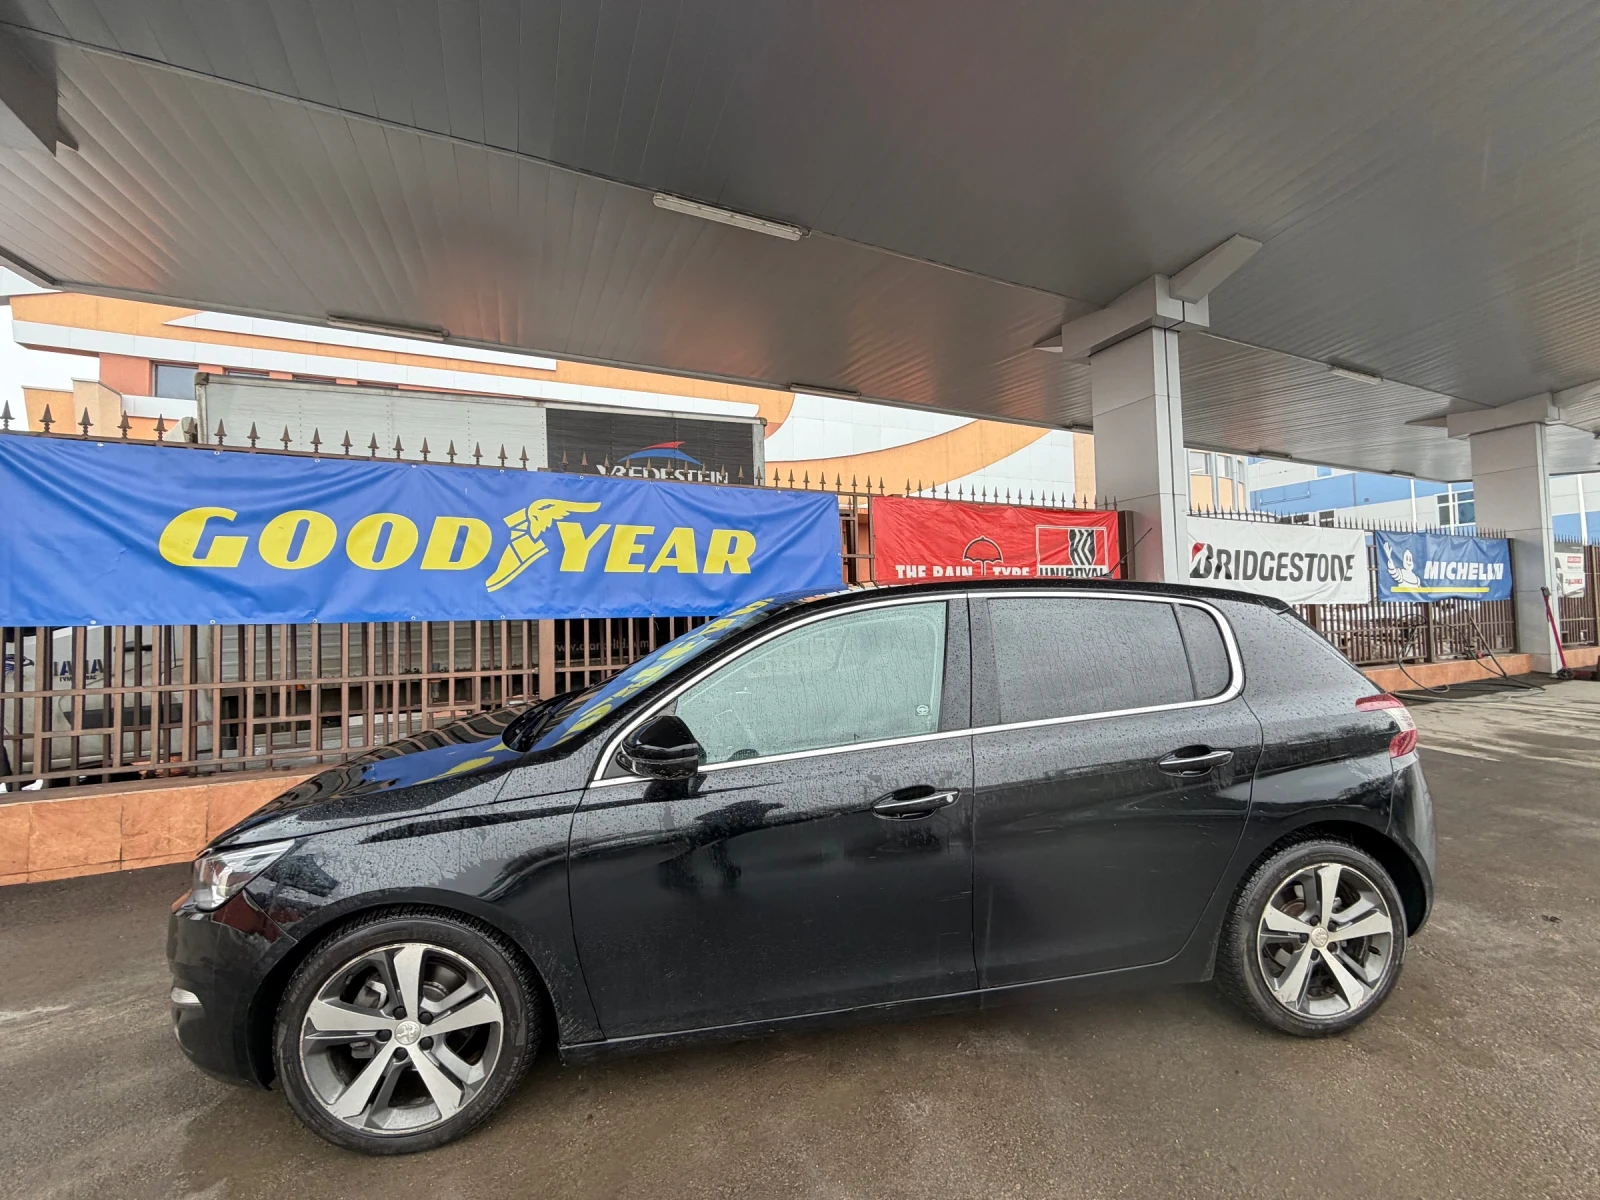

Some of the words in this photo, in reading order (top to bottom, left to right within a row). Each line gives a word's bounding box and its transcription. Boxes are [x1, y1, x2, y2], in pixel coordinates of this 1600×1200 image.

[895, 564, 927, 579] THE
[1189, 541, 1356, 582] BRIDGESTONE
[1423, 560, 1504, 581] MICHELIN
